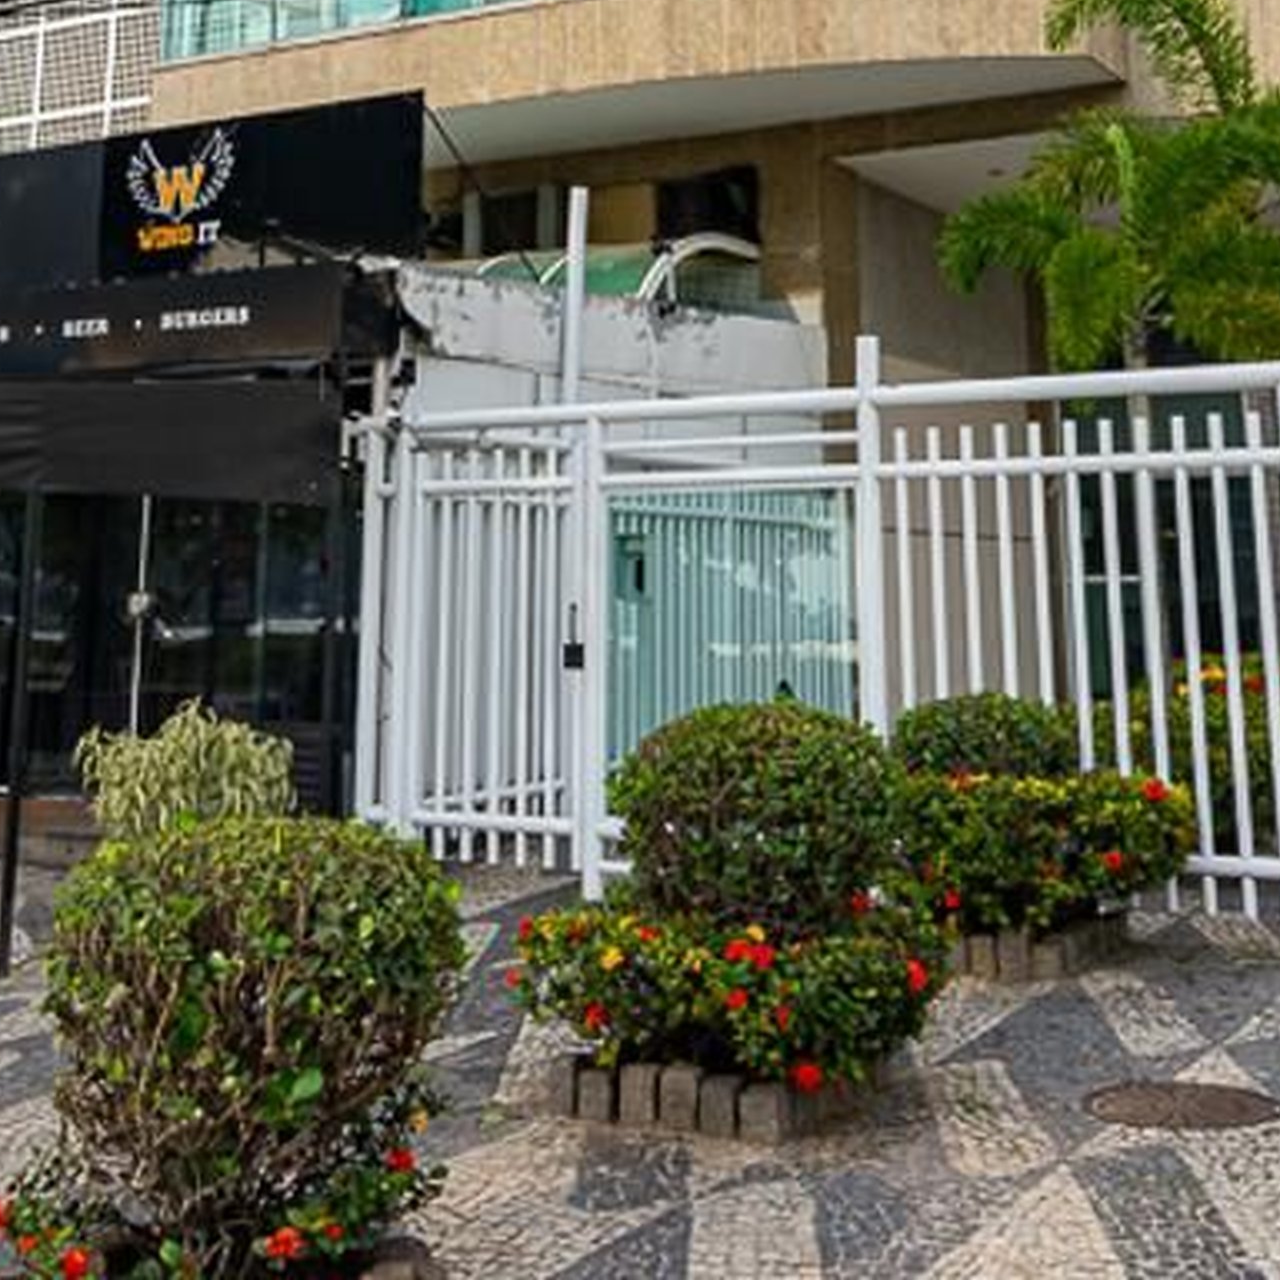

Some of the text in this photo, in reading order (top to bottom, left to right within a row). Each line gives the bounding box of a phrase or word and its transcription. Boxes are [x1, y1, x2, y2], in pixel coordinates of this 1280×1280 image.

[137, 218, 221, 251] WING IT
[61, 318, 110, 338] BEER
[159, 305, 250, 331] BURGERS
